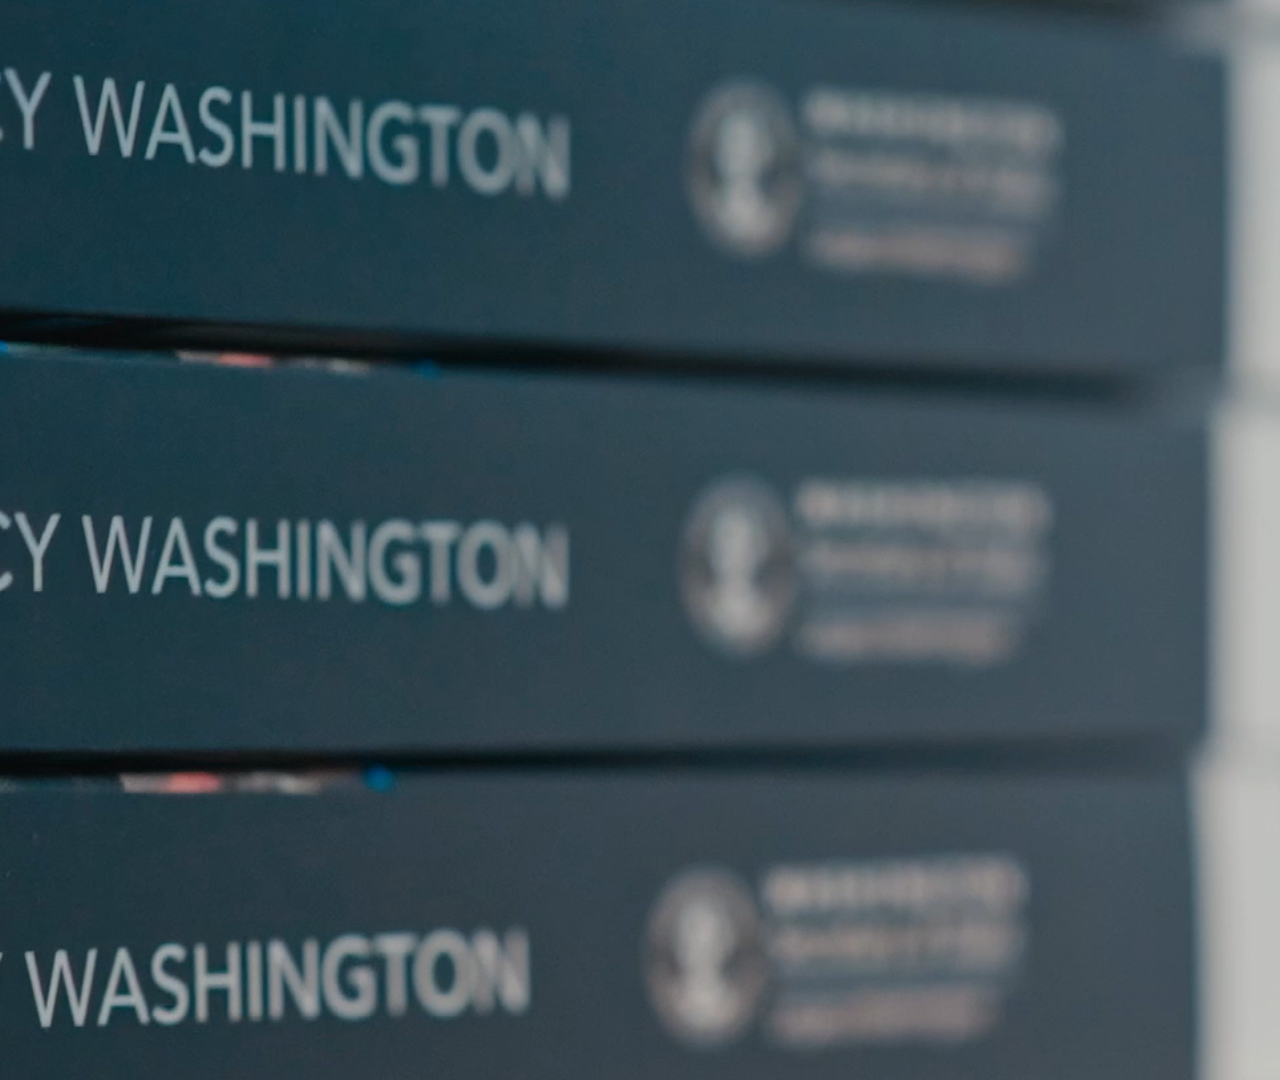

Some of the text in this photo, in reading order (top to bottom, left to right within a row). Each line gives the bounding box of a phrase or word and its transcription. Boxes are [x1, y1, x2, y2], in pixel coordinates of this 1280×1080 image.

[72, 75, 572, 200] WASHINGTON
[81, 514, 570, 609] WASHINGTON
[24, 929, 532, 1029] WASHINGTON
